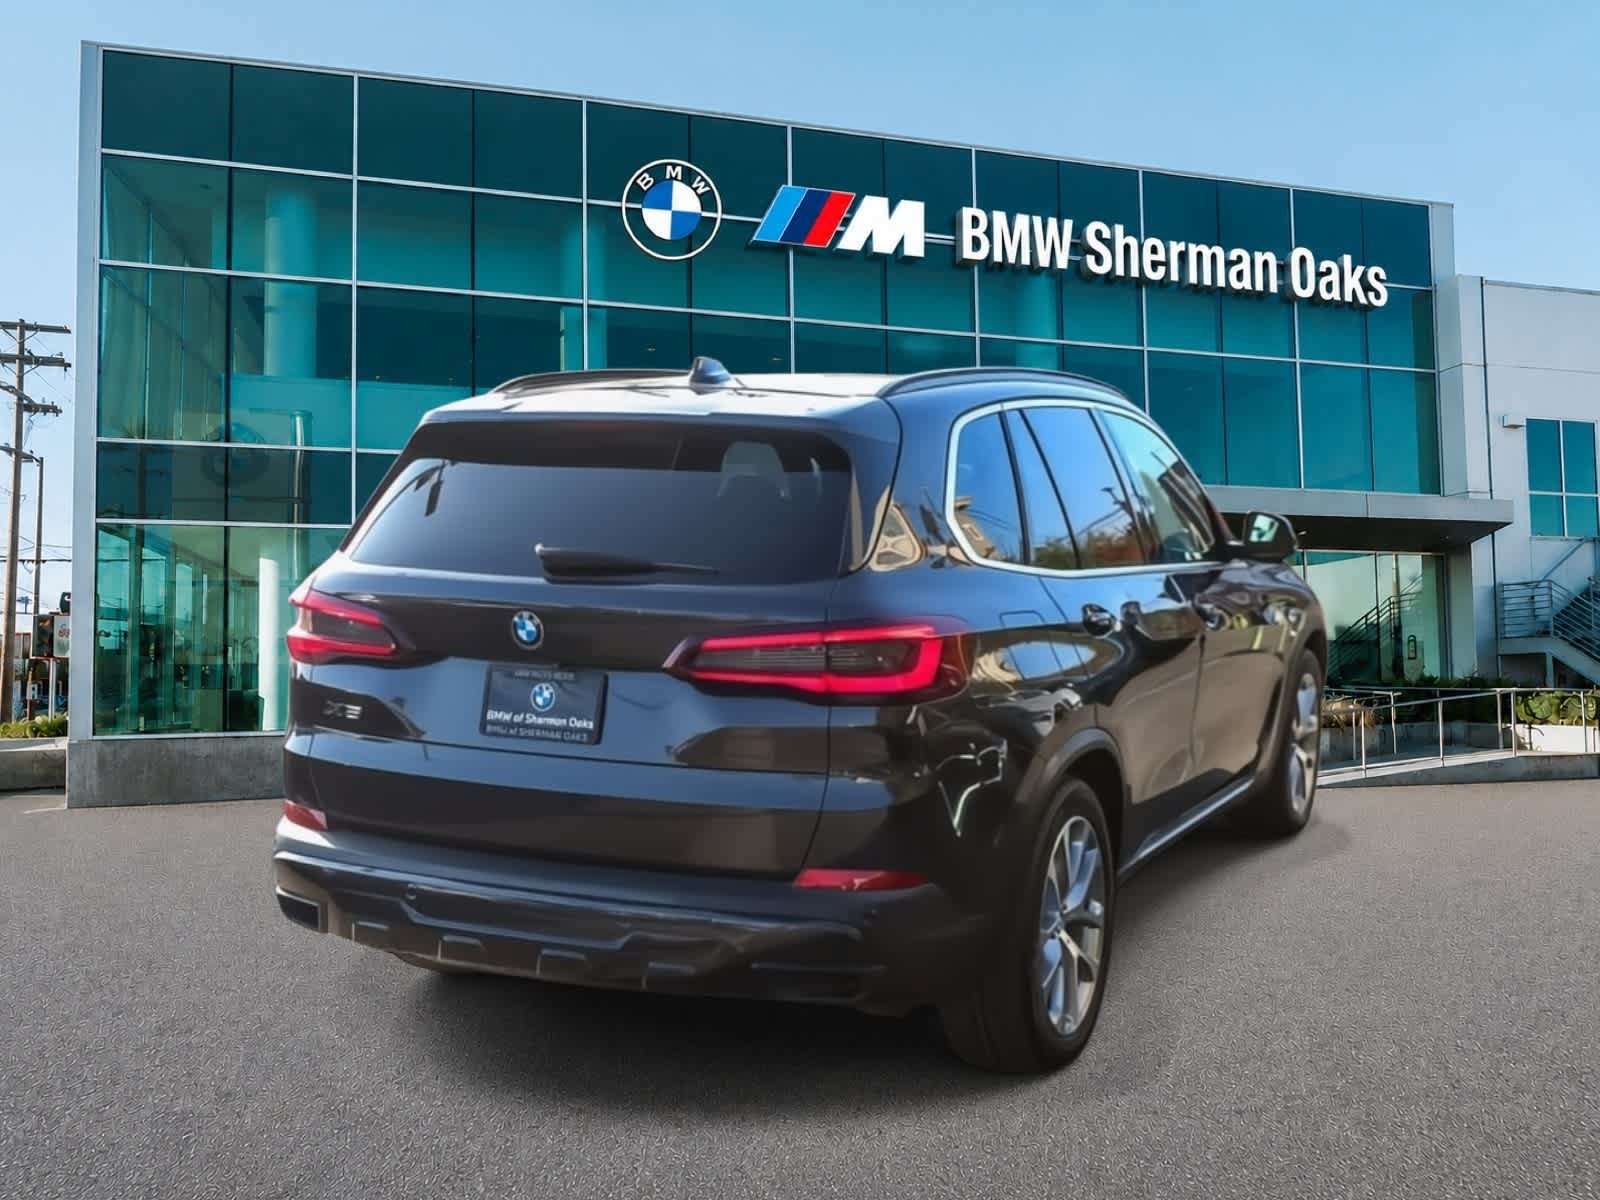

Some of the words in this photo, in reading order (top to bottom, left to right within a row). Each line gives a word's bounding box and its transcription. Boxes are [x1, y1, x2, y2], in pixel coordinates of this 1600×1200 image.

[636, 165, 711, 196] BMW
[836, 194, 925, 258] M
[961, 206, 1074, 270] BMW
[1084, 220, 1278, 294] Sherman
[1289, 247, 1389, 308] Oaks
[486, 709, 513, 722] BMW
[513, 711, 525, 723] of
